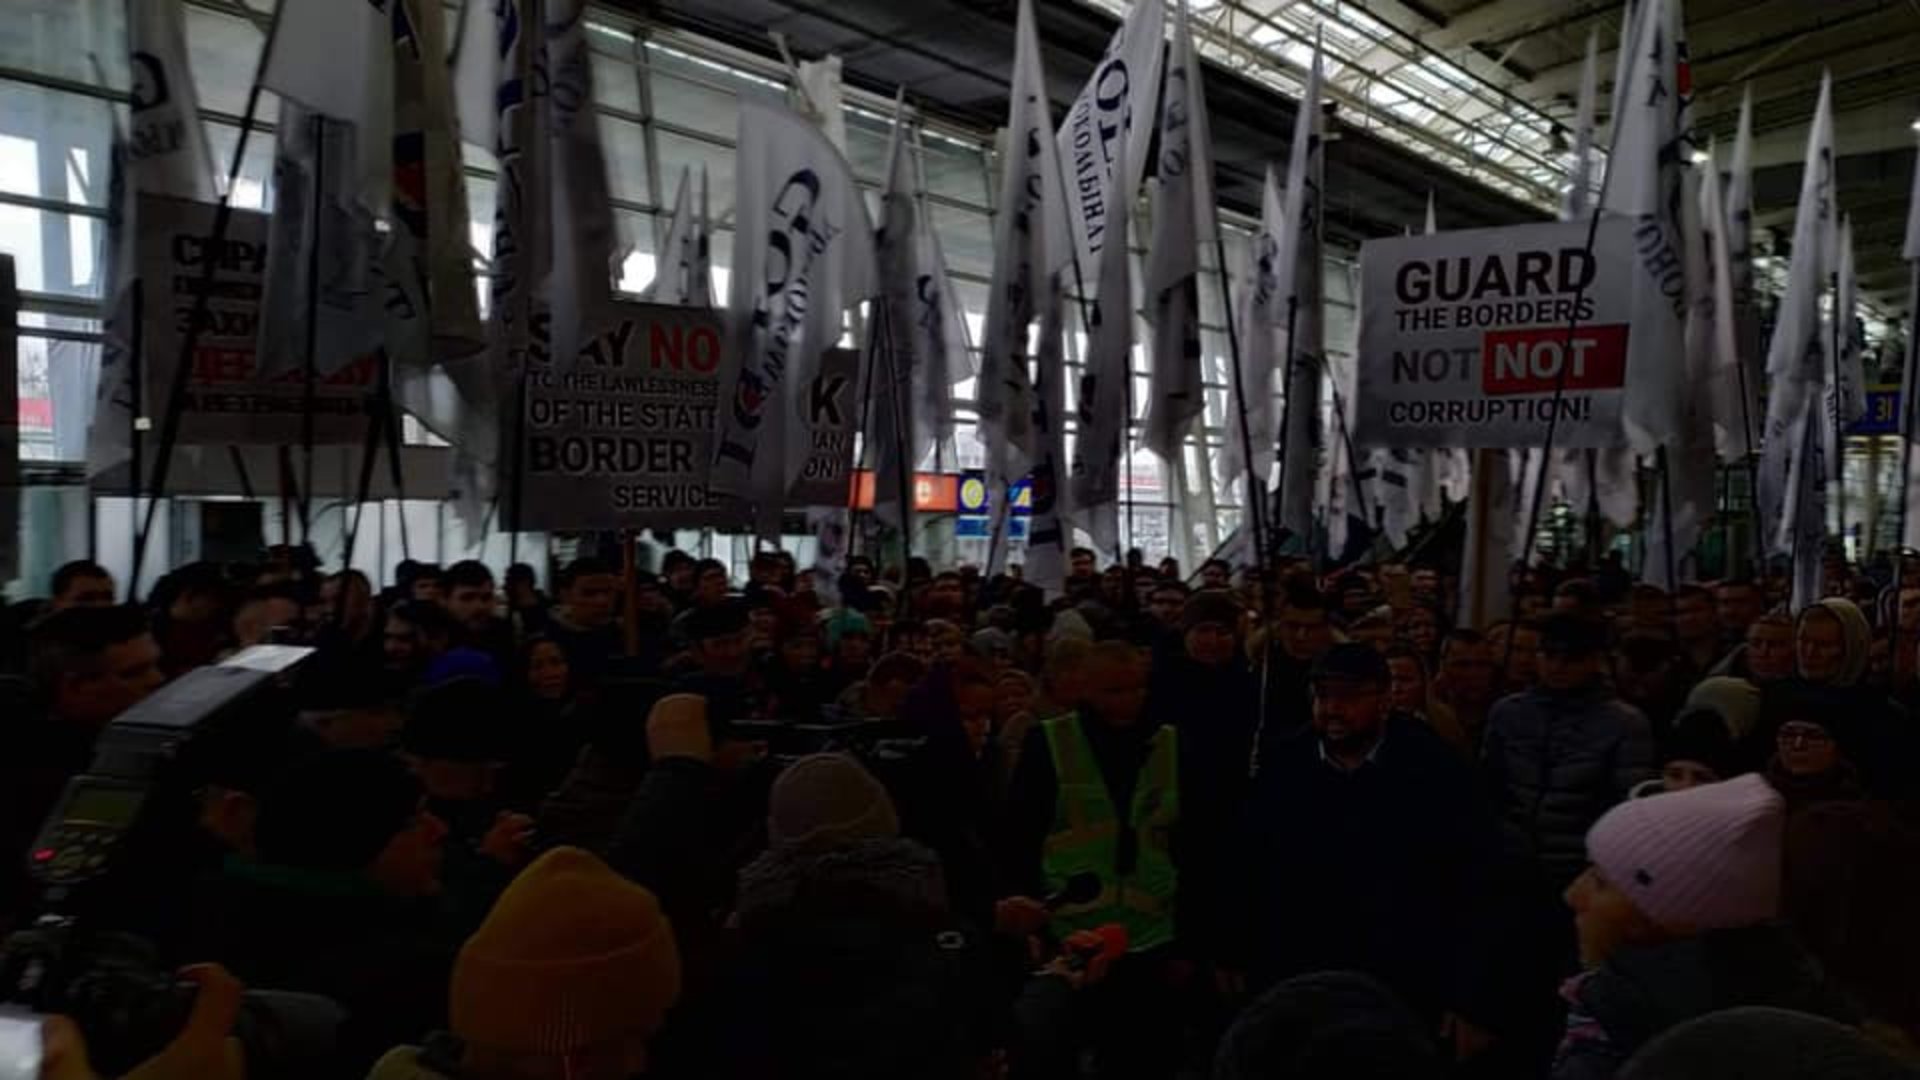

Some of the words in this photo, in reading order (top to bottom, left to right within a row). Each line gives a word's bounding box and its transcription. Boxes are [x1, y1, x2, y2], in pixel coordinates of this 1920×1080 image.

[1396, 248, 1596, 304] GUARD
[1395, 307, 1448, 331] THE
[1456, 298, 1595, 328] BORDERS
[650, 322, 721, 373] NO
[1392, 349, 1480, 385] NOT
[1494, 337, 1600, 381] NOT
[531, 399, 568, 425] OF
[574, 400, 635, 427] THE
[1390, 397, 1592, 424] CORRUPTION!
[530, 436, 693, 472] BORDER
[614, 484, 720, 509] SERVICE
